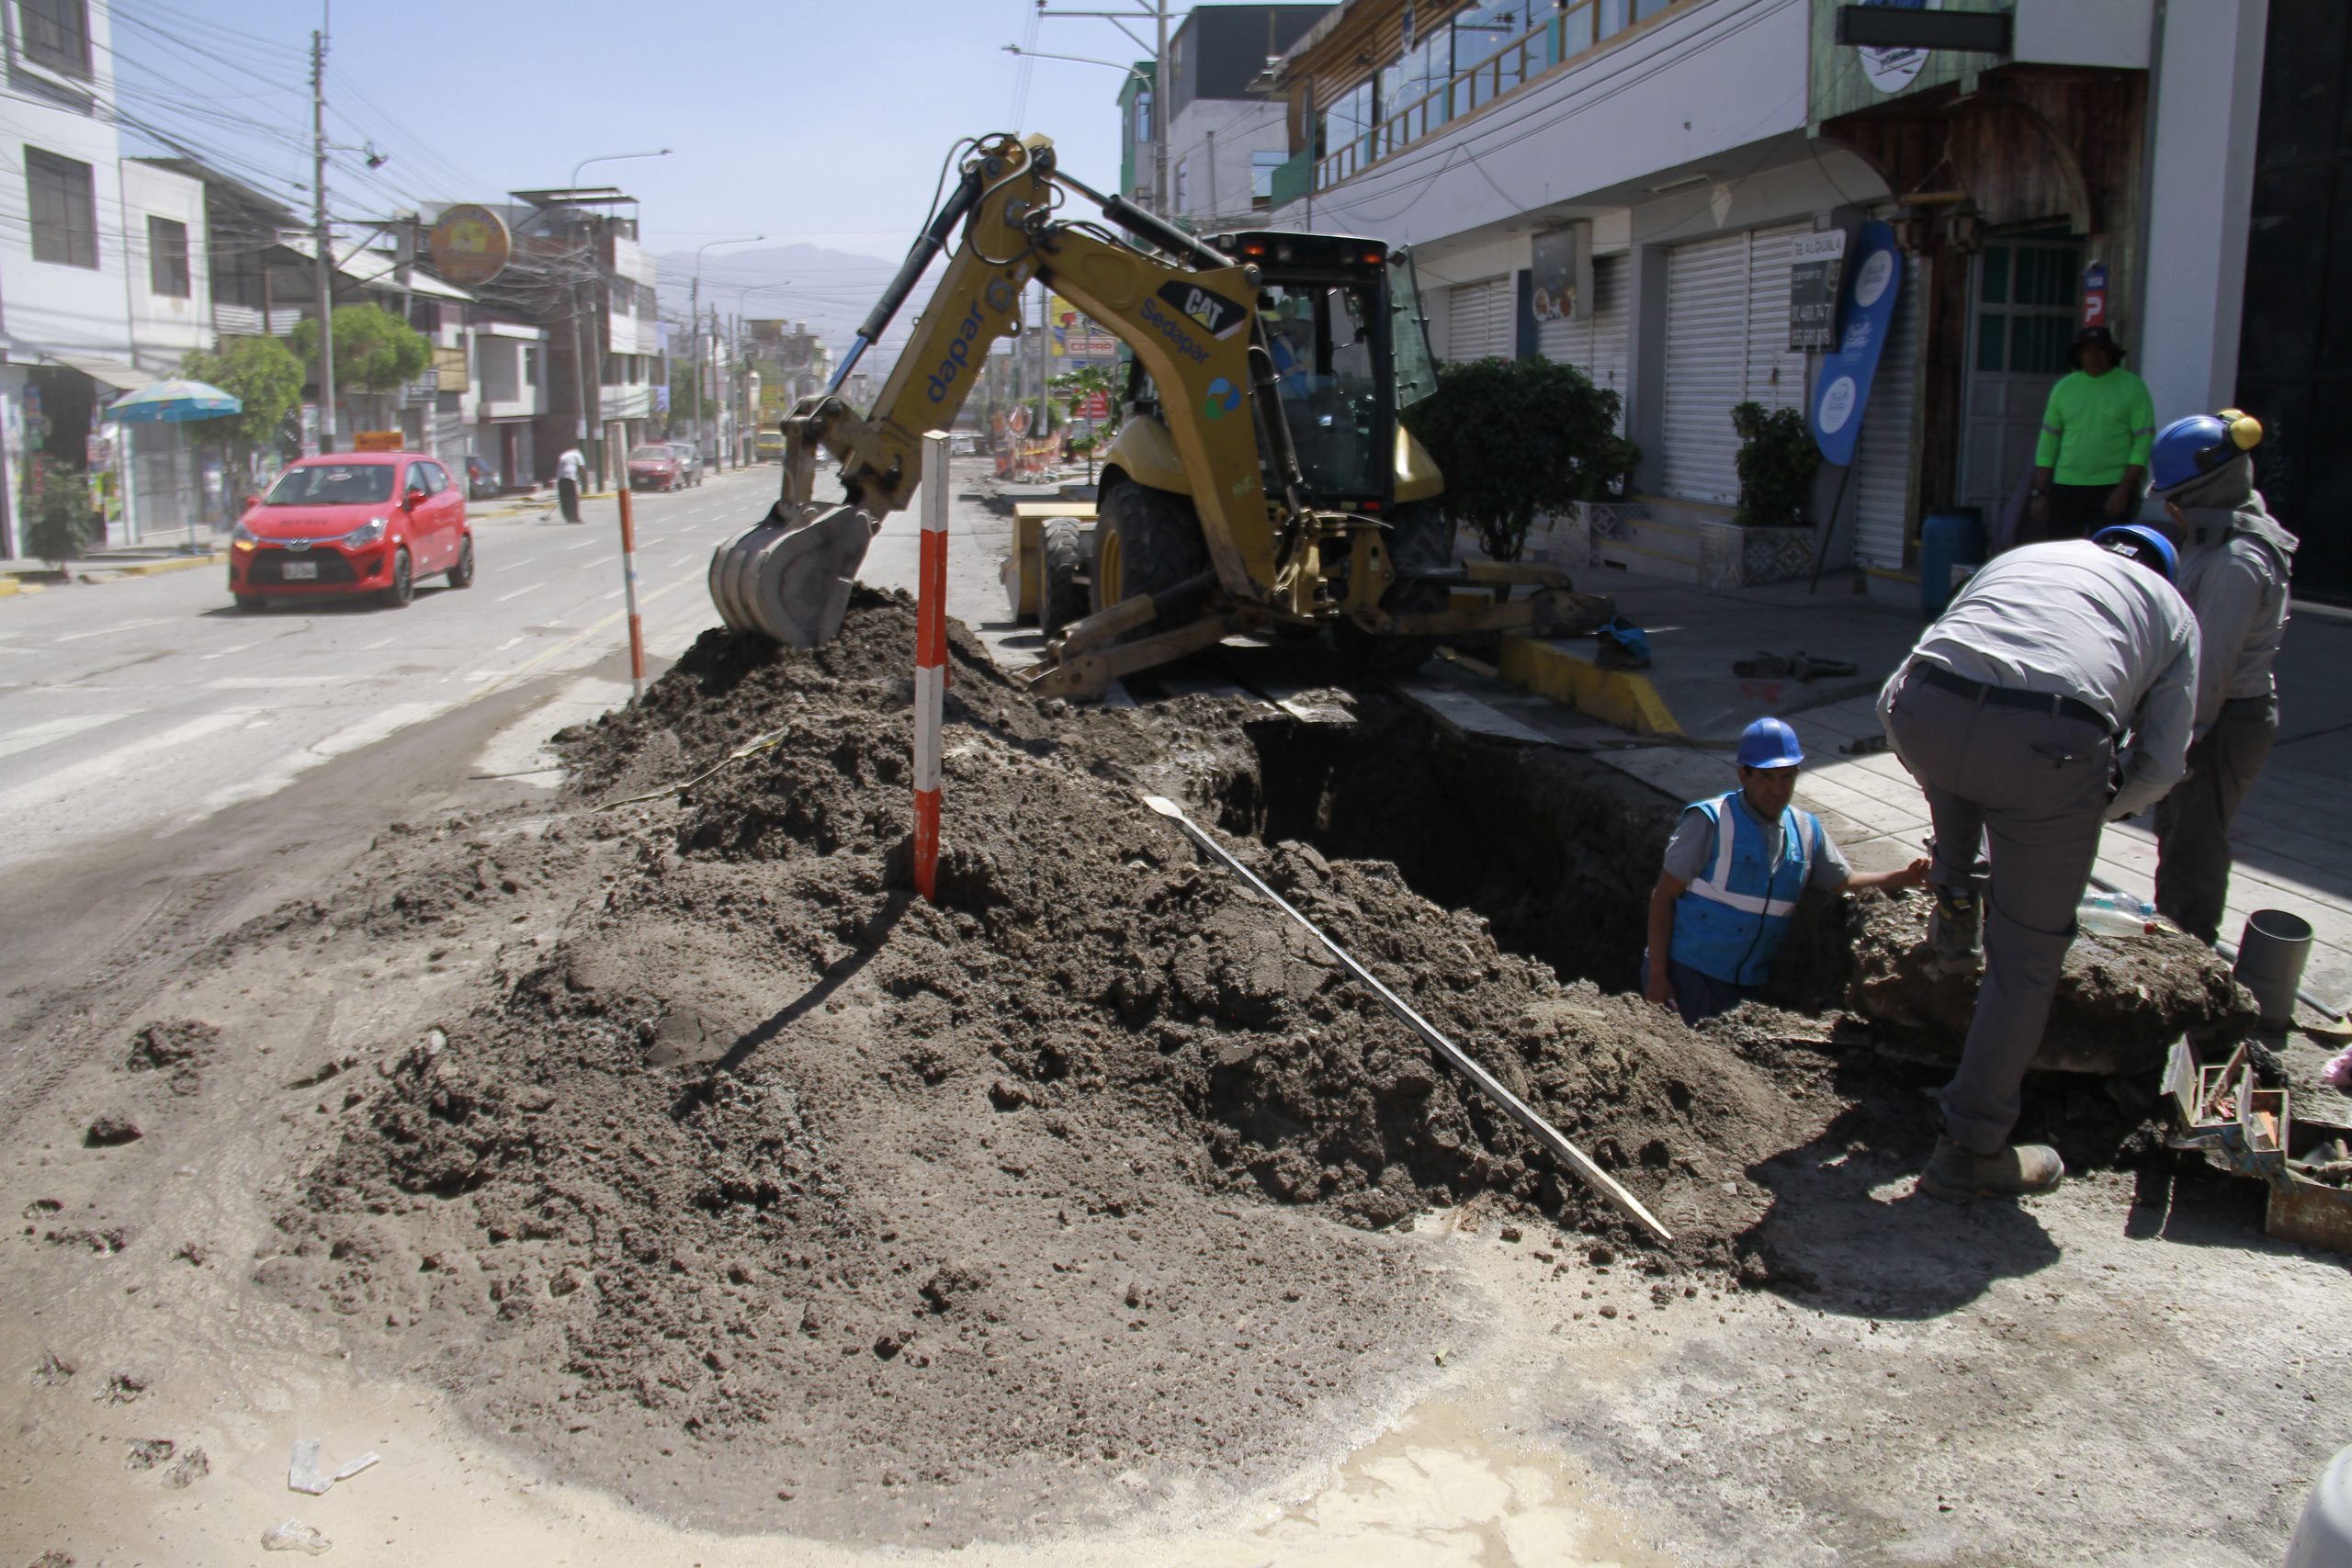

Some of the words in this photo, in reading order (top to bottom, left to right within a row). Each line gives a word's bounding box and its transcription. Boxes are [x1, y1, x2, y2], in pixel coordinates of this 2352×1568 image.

[1805, 238, 1841, 254] ALQUILA
[1140, 297, 1210, 365] Sedapar
[1184, 288, 1224, 331] CAT
[927, 298, 985, 403] dapar
